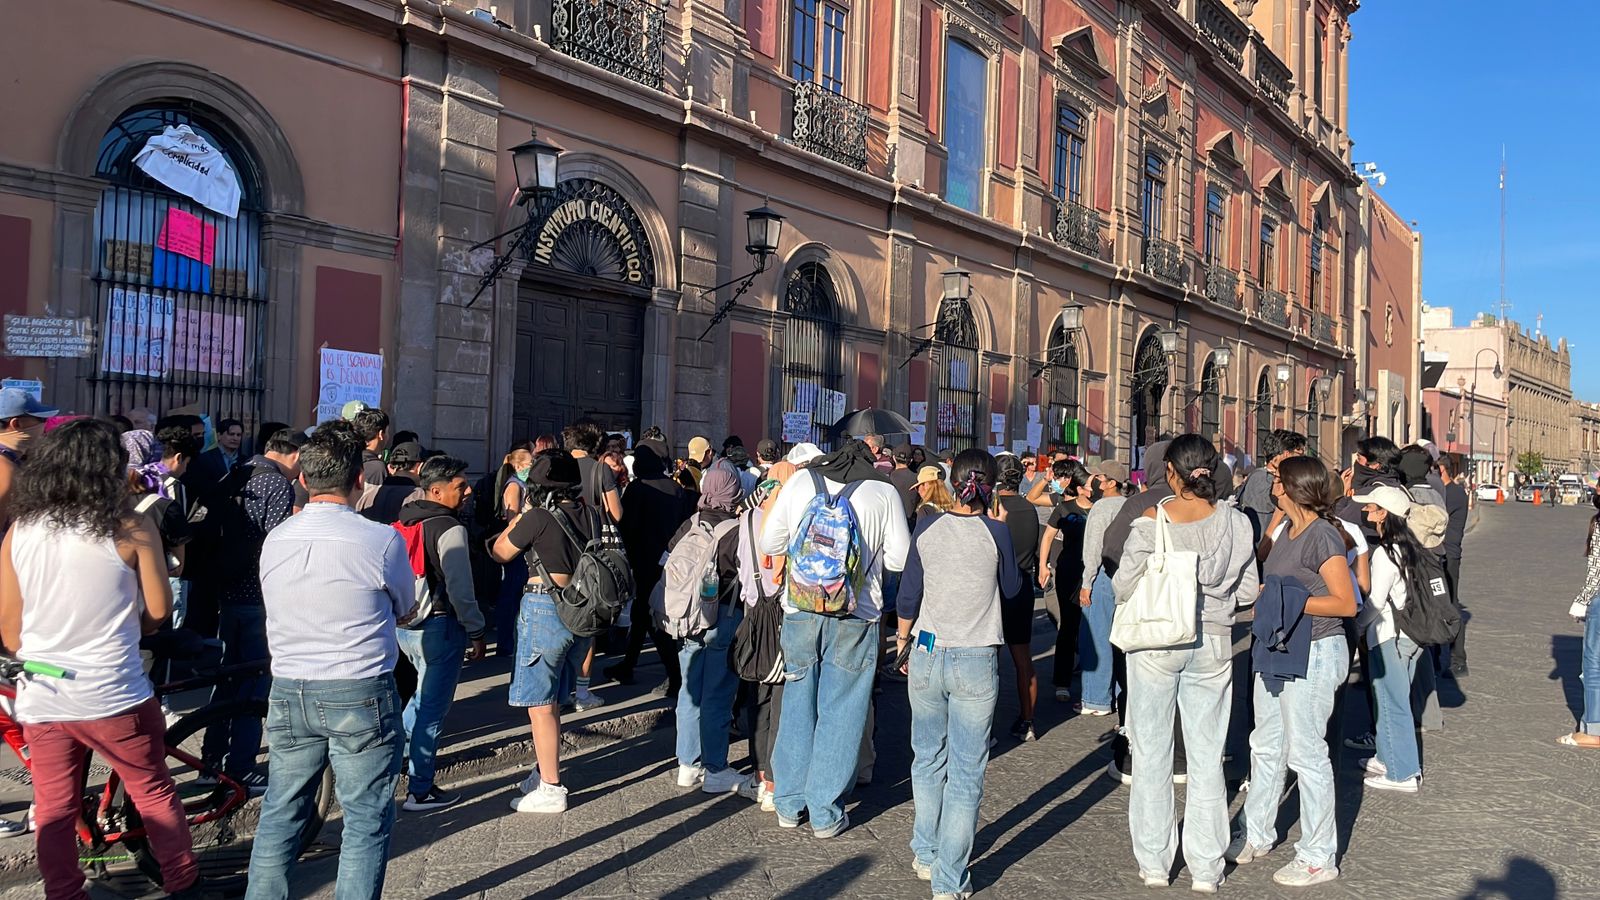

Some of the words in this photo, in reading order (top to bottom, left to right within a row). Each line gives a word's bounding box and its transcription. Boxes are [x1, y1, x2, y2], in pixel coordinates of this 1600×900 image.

[535, 199, 587, 265] INSTITUTO
[590, 200, 642, 282] CIENTIFICO
[323, 353, 333, 366] NO
[337, 353, 344, 367] ES
[327, 368, 335, 380] ES
[340, 367, 380, 386] DENUNCIA
